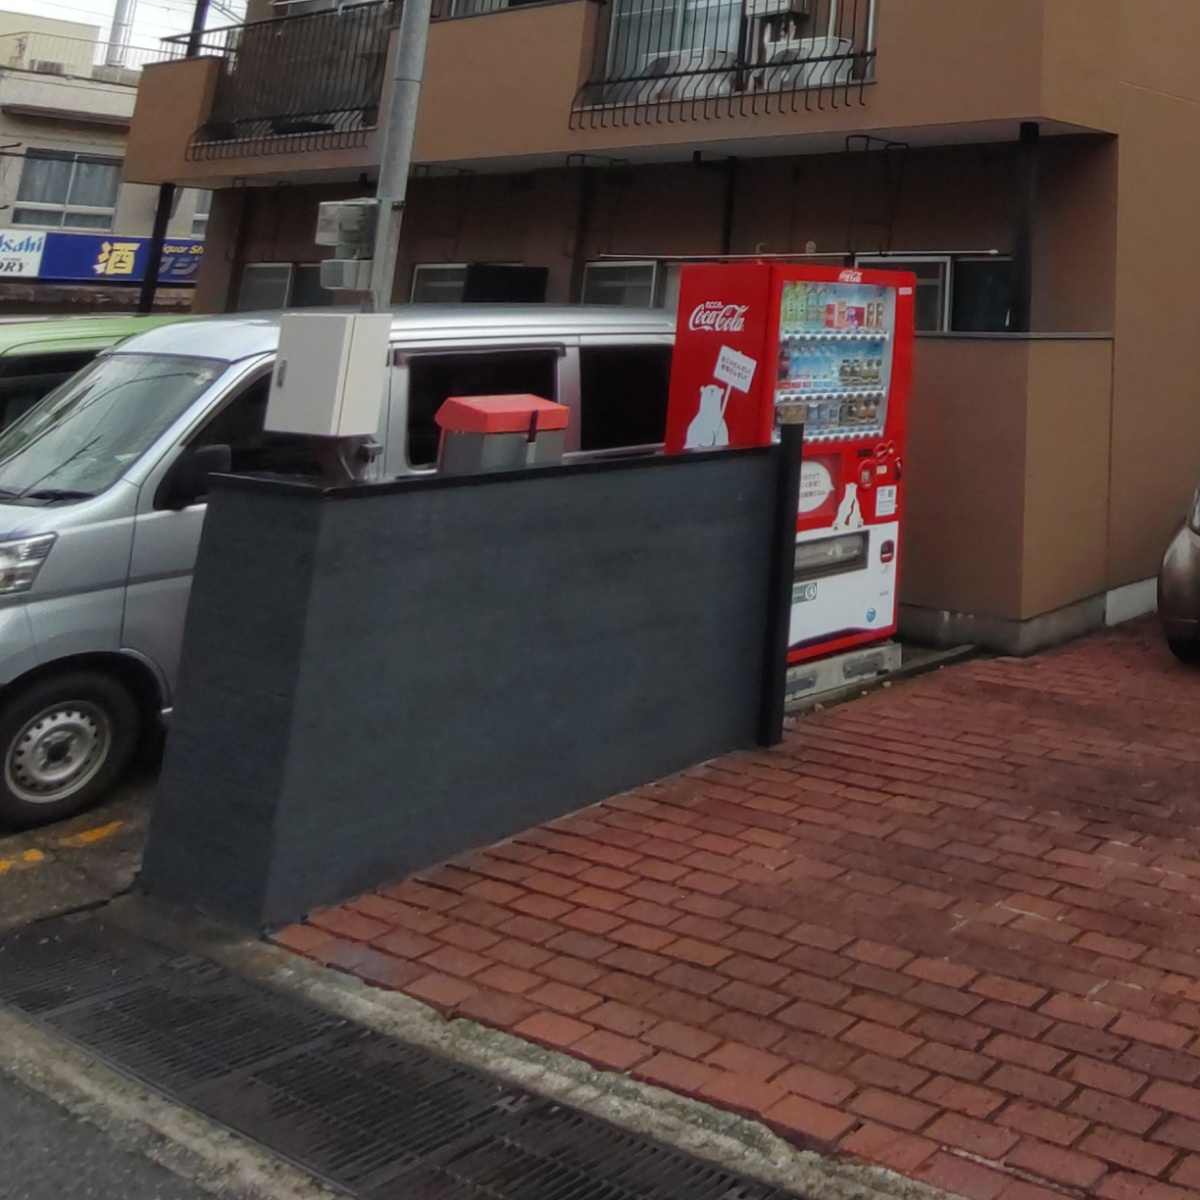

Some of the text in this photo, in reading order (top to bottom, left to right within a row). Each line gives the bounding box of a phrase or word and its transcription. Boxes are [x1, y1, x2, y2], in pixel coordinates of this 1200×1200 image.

[93, 241, 141, 274] 酒
[163, 244, 204, 254] iquor Sh
[689, 303, 749, 331] Coca-Cola
